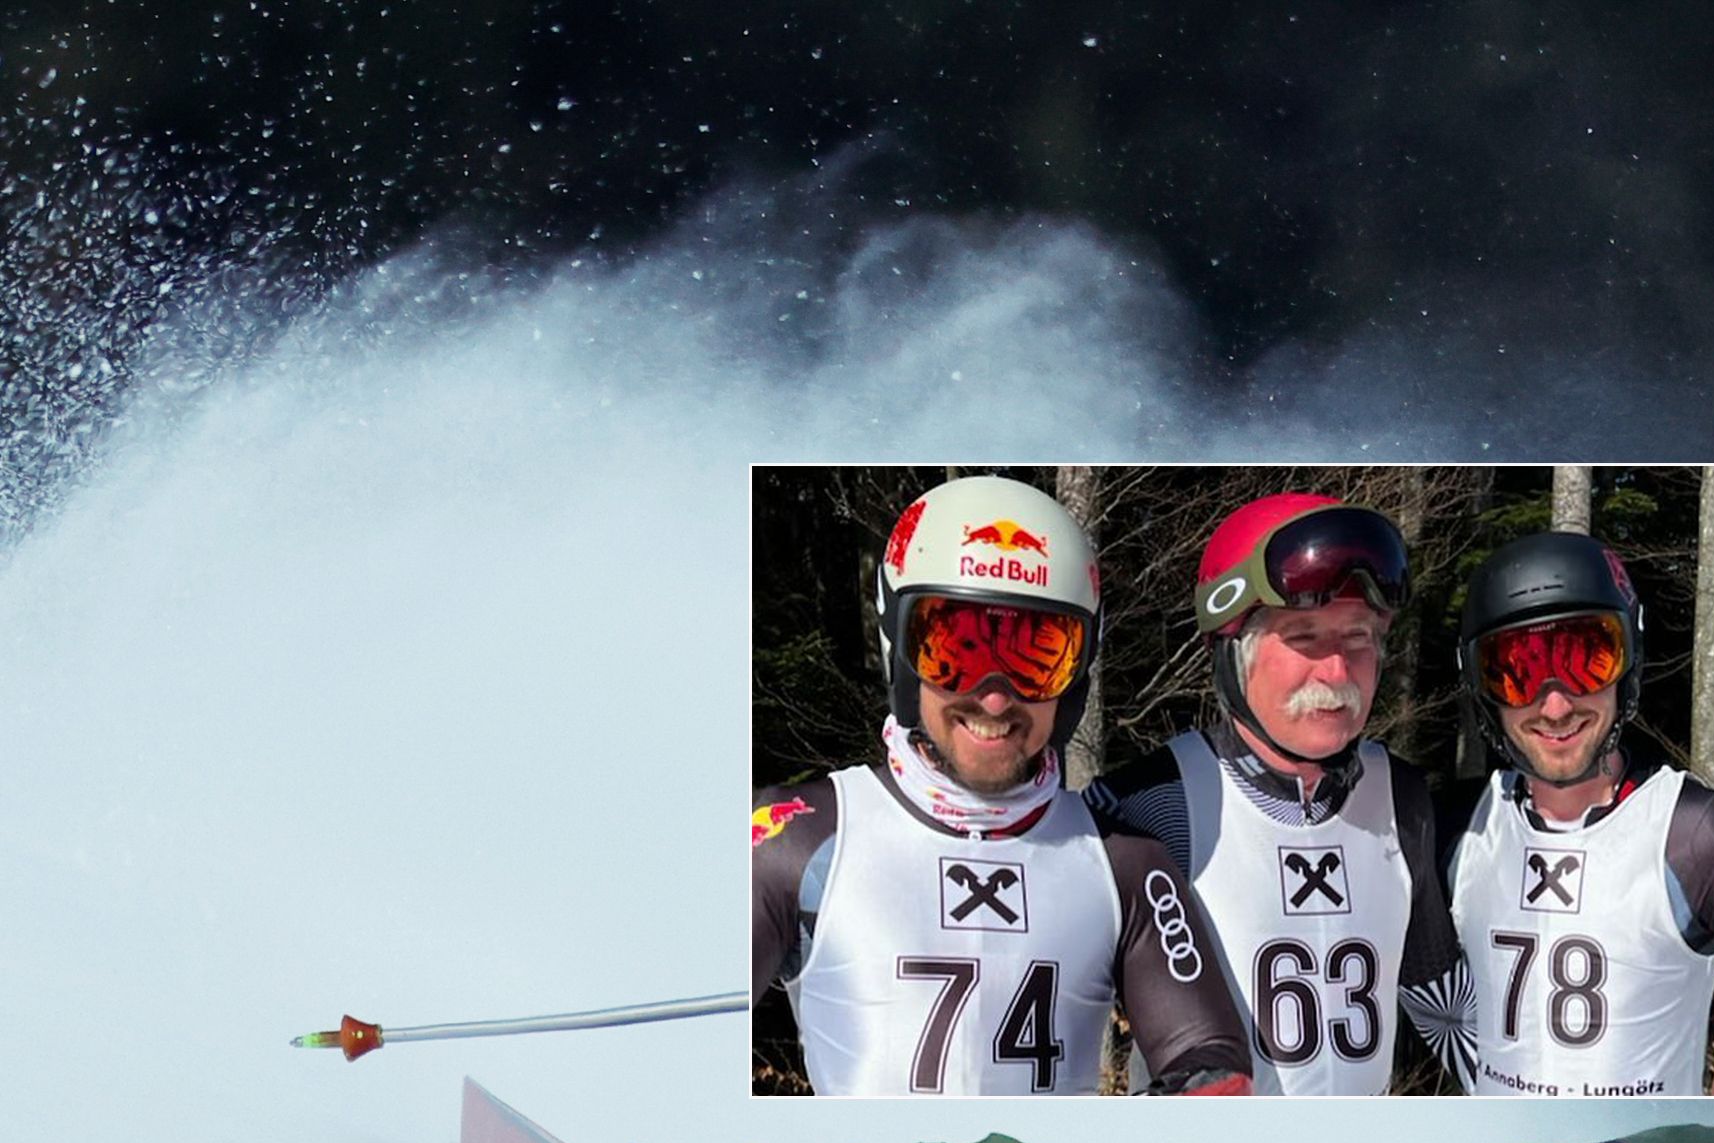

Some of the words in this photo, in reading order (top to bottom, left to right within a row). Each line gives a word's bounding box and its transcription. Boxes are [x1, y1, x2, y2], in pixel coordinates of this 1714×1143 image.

[960, 556, 1004, 578] Red
[1008, 560, 1047, 587] Bull
[896, 956, 1065, 1094] 74
[1252, 936, 1384, 1069] 63
[1491, 929, 1609, 1050] 78
[1484, 1064, 1559, 1097] Annaberg
[1583, 1080, 1665, 1097] Lungötz
